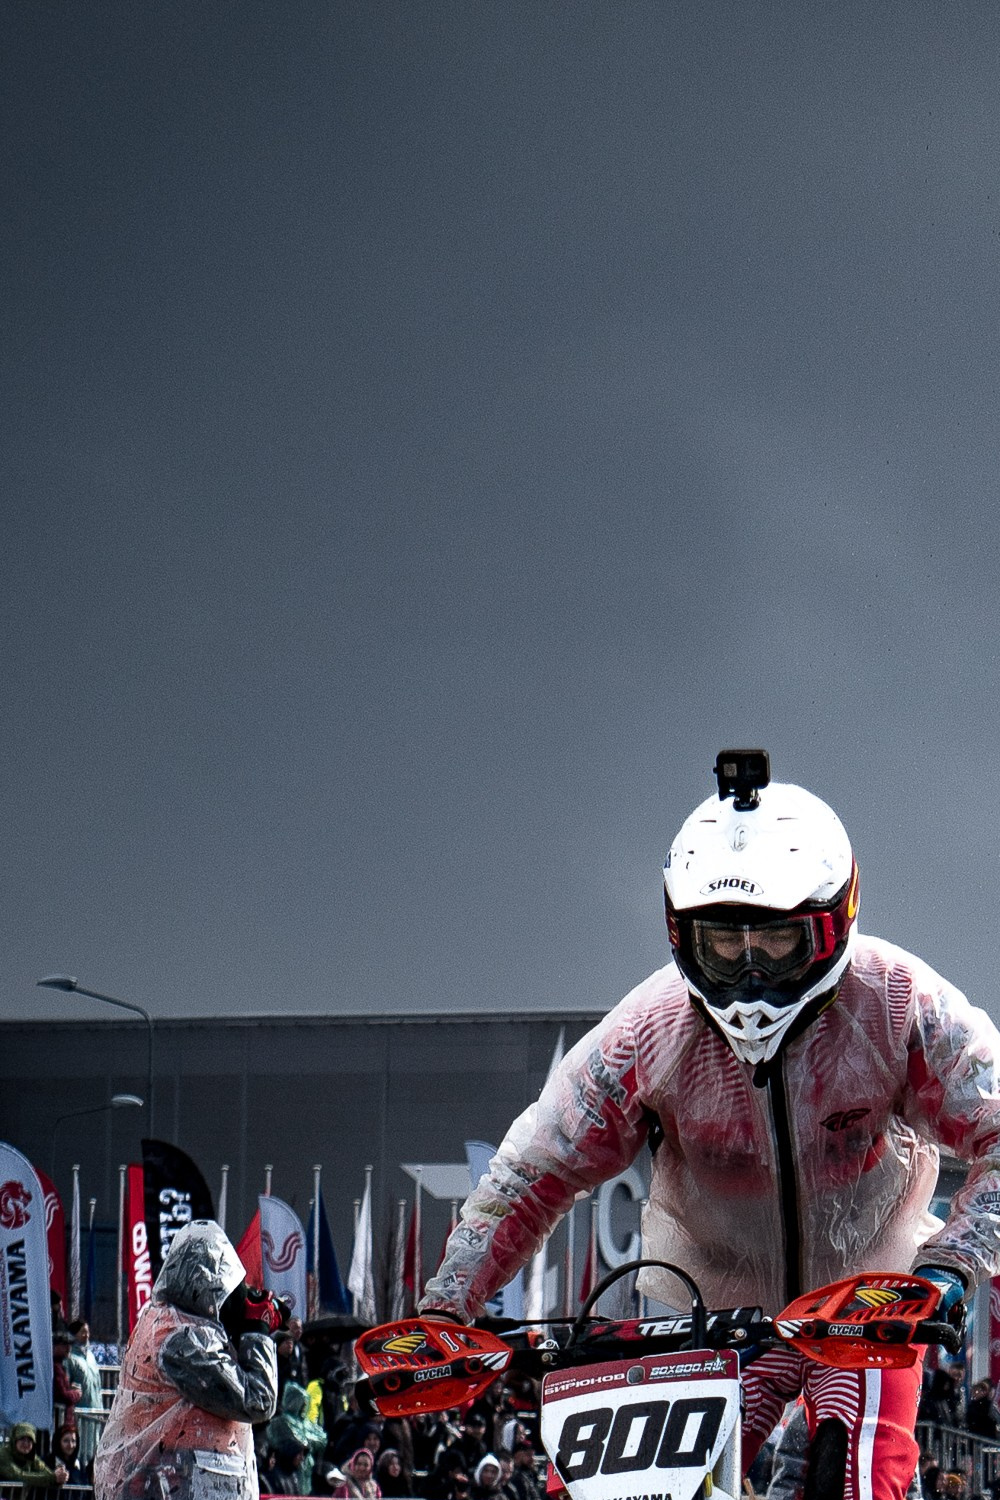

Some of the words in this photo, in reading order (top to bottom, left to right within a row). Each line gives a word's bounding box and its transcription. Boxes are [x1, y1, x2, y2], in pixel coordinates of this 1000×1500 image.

[707, 878, 756, 894] SHOEI
[6, 1238, 37, 1399] TAKAYAMA
[828, 1325, 864, 1337] CYCRA
[414, 1365, 452, 1382] CYCRA
[558, 1396, 728, 1483] 800
